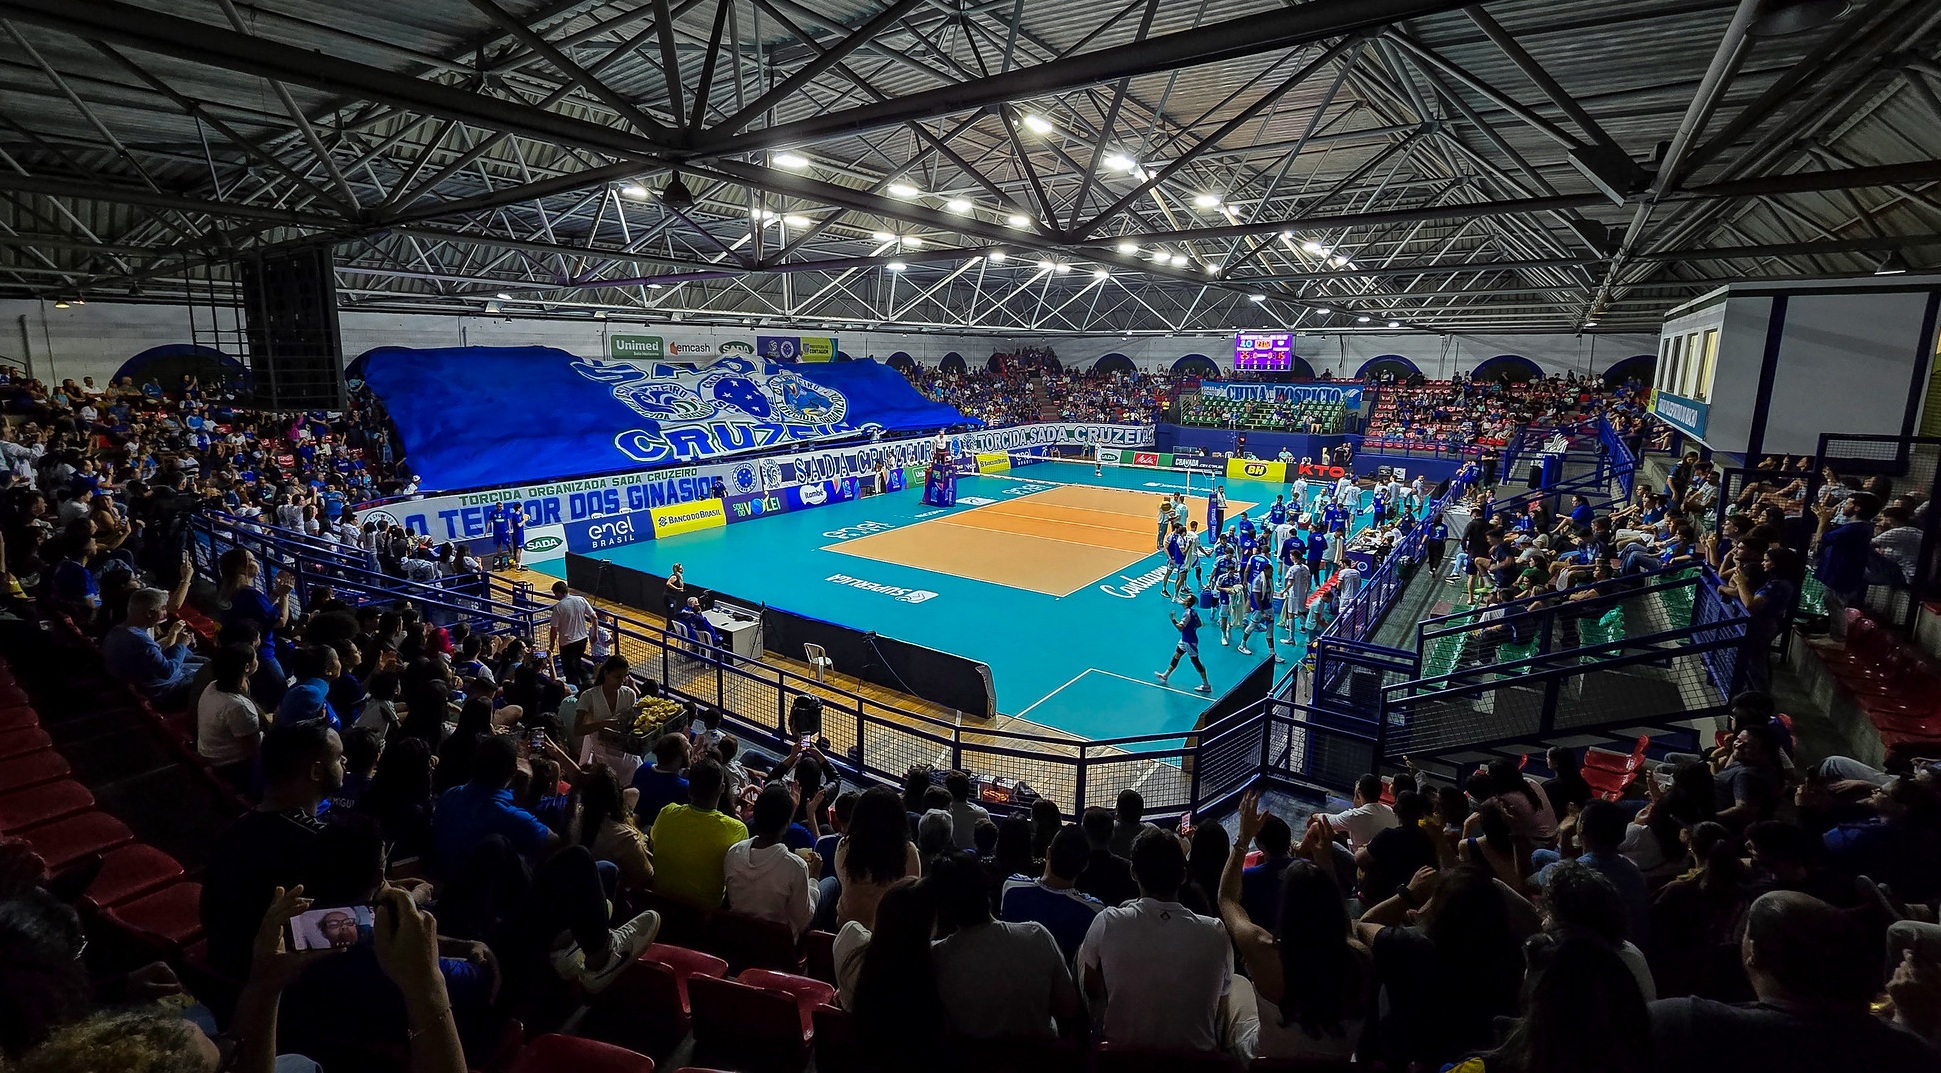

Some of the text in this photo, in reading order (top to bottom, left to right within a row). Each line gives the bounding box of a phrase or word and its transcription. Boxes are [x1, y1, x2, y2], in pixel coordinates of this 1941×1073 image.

[616, 340, 659, 351] Unimed
[677, 343, 711, 352] emcash
[1226, 385, 1267, 401] CHINA
[1274, 386, 1342, 403] HOSPICIO
[614, 420, 883, 463] CRUZEI
[978, 428, 1030, 452] TORCIDA
[1029, 426, 1069, 446] SADA
[794, 452, 851, 485] SADA
[1247, 465, 1264, 475] BH
[1298, 463, 1345, 478] KTO
[459, 468, 698, 507] TORCIDA ORGANIZADA SADA CRUZEIRO
[569, 487, 618, 520] DOS
[668, 514, 691, 524] BANCO
[699, 509, 721, 518] BRASIL
[588, 515, 635, 540] enel
[526, 538, 559, 550] SADA
[592, 534, 635, 548] BRASIL
[825, 573, 912, 598] SUPERLIGA
